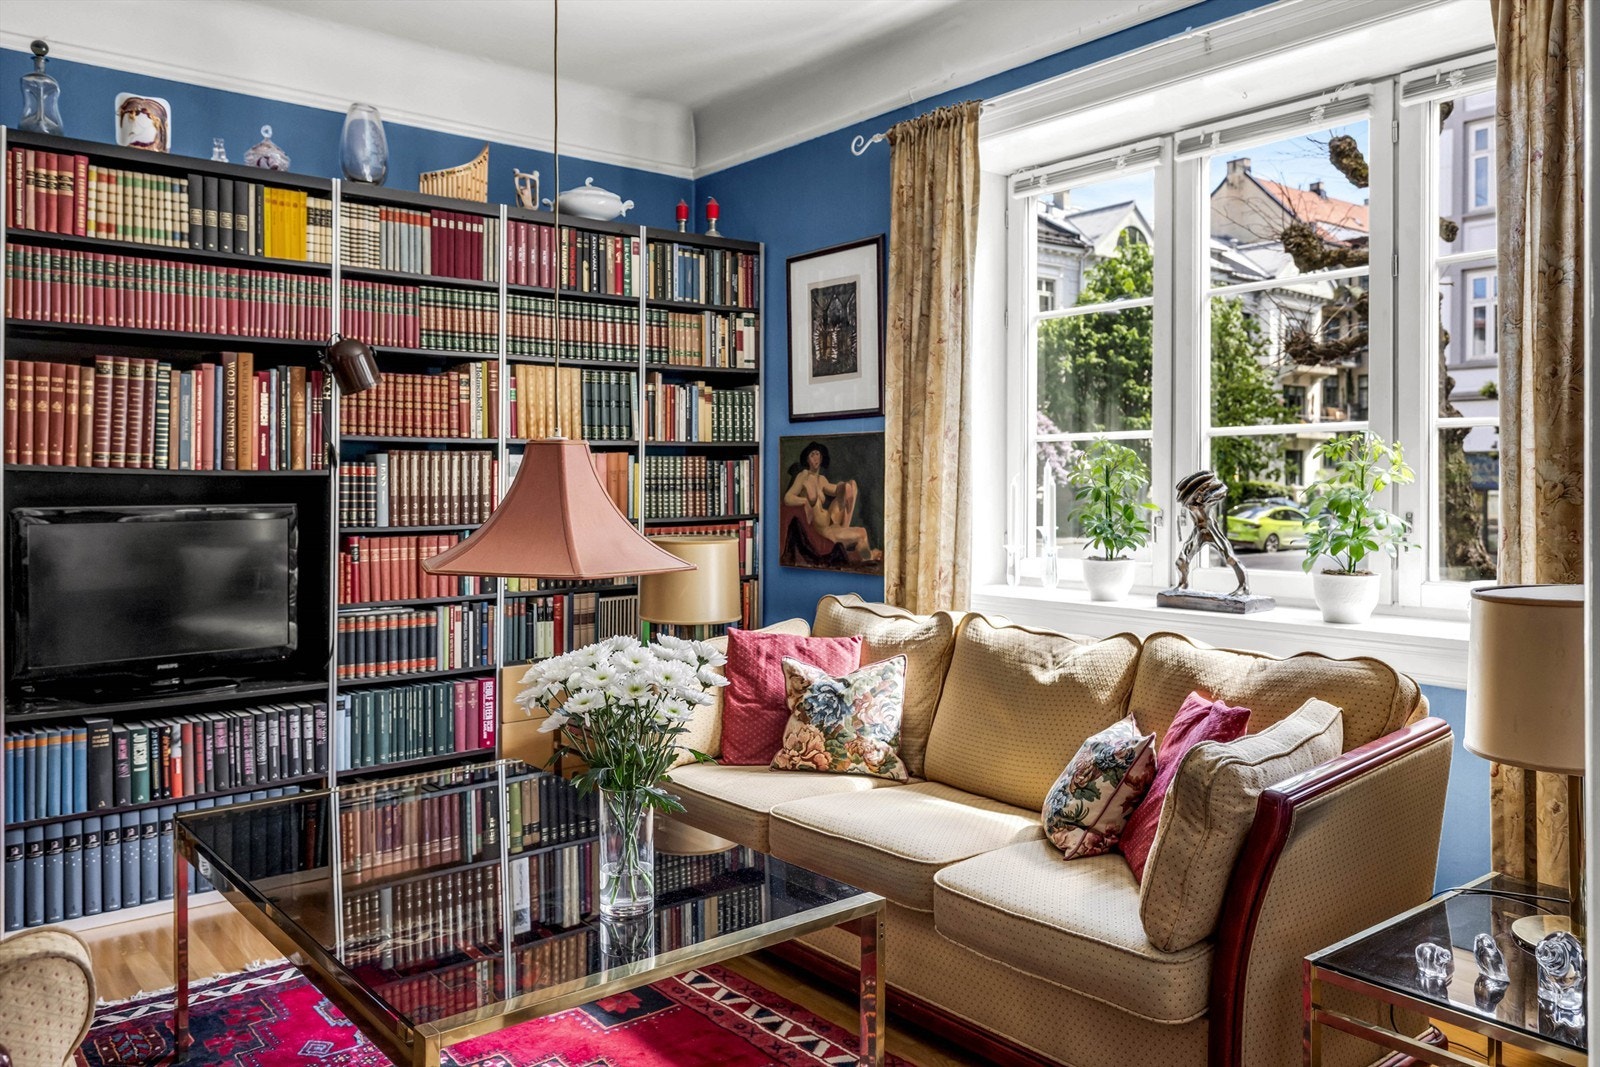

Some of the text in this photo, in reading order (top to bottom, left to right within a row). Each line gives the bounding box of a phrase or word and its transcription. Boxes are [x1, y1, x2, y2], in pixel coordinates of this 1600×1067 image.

[225, 362, 236, 453] WORLD FURNITURE
[241, 360, 250, 457] WORLD ARCHITECTURE
[260, 393, 268, 426] MUNCH
[485, 702, 493, 720] STEEN
